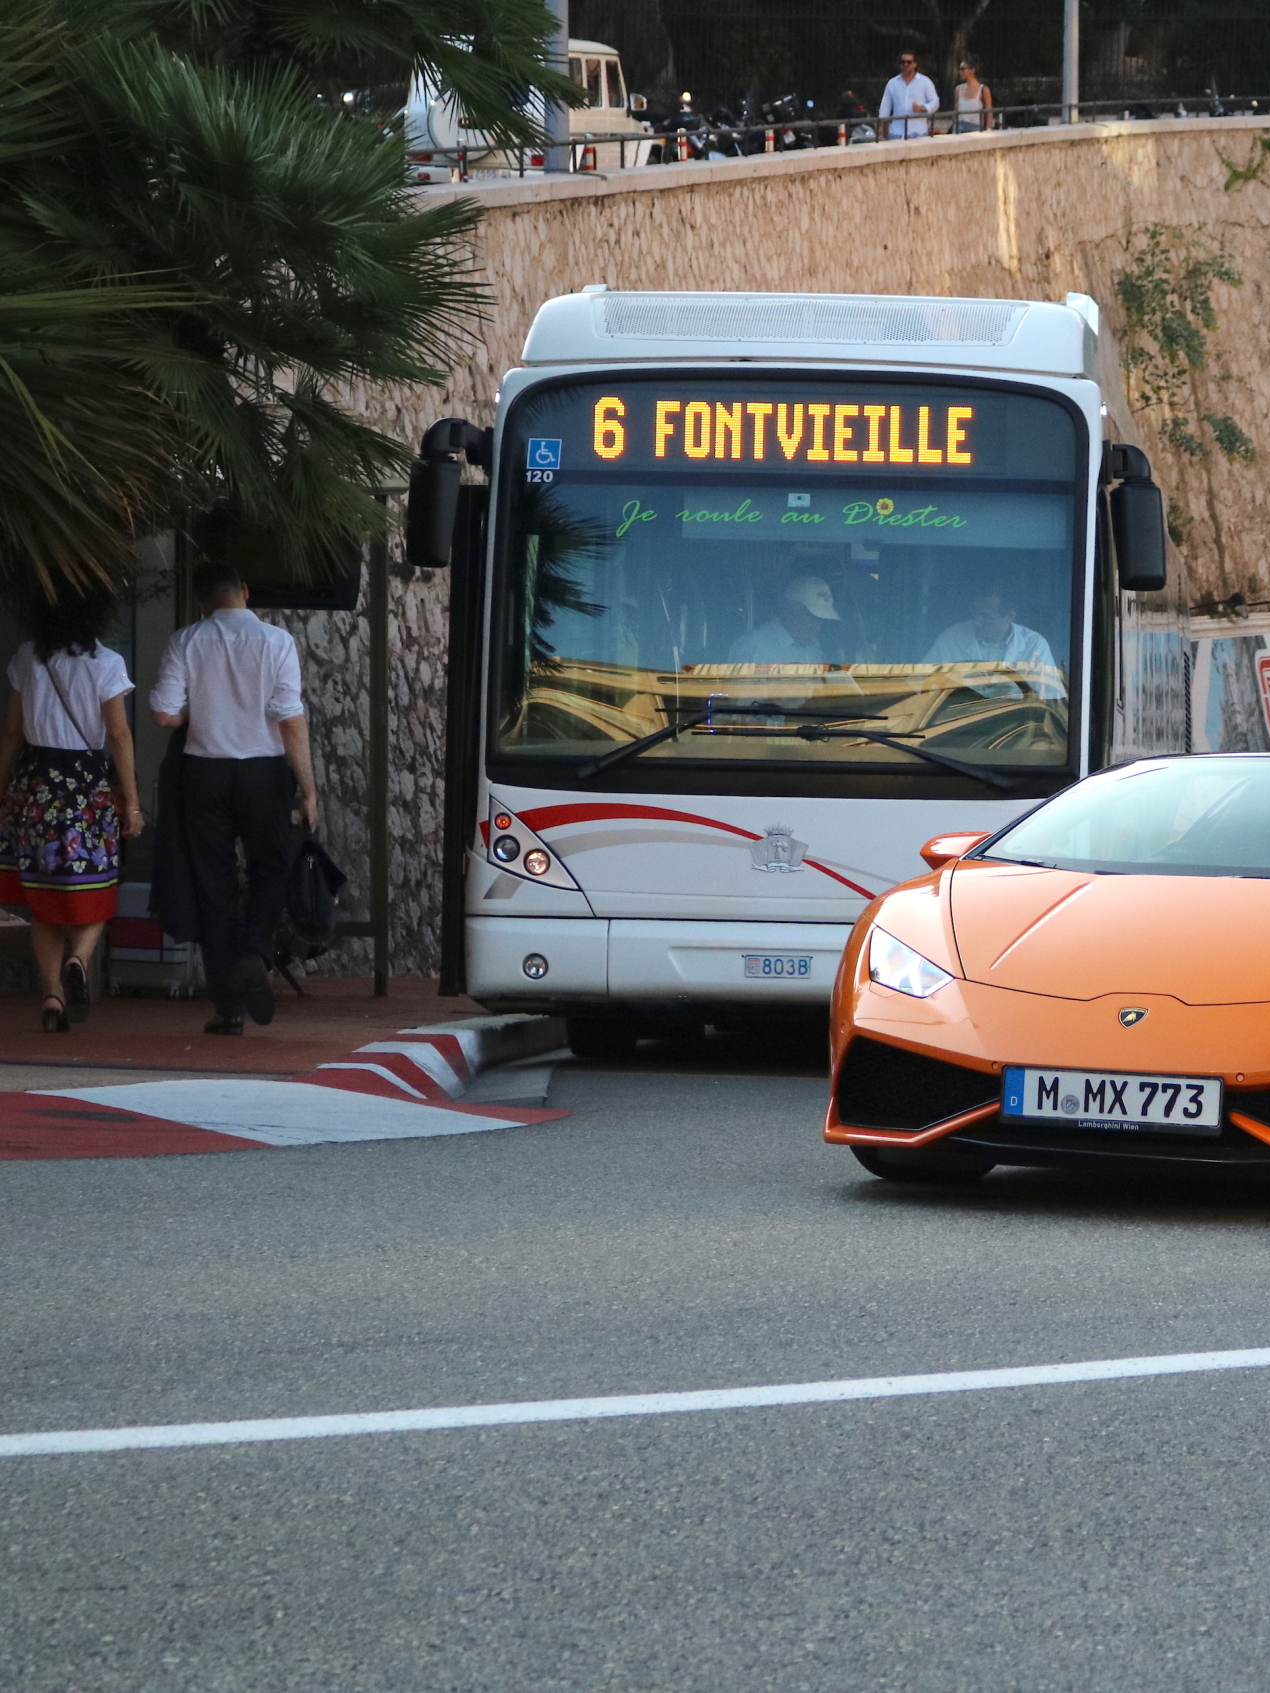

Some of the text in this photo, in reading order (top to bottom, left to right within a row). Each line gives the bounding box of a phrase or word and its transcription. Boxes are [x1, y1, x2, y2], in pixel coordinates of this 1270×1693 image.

[593, 396, 974, 464] 6 FONTVIEILLE
[526, 470, 554, 483] 120
[615, 500, 658, 537] Je
[675, 499, 764, 523] roule
[781, 511, 825, 524] au
[762, 958, 808, 975] 803B
[1010, 1097, 1018, 1107] D
[1037, 1076, 1205, 1119] M MX 773
[1078, 1120, 1139, 1131] Lamborghini Wien
